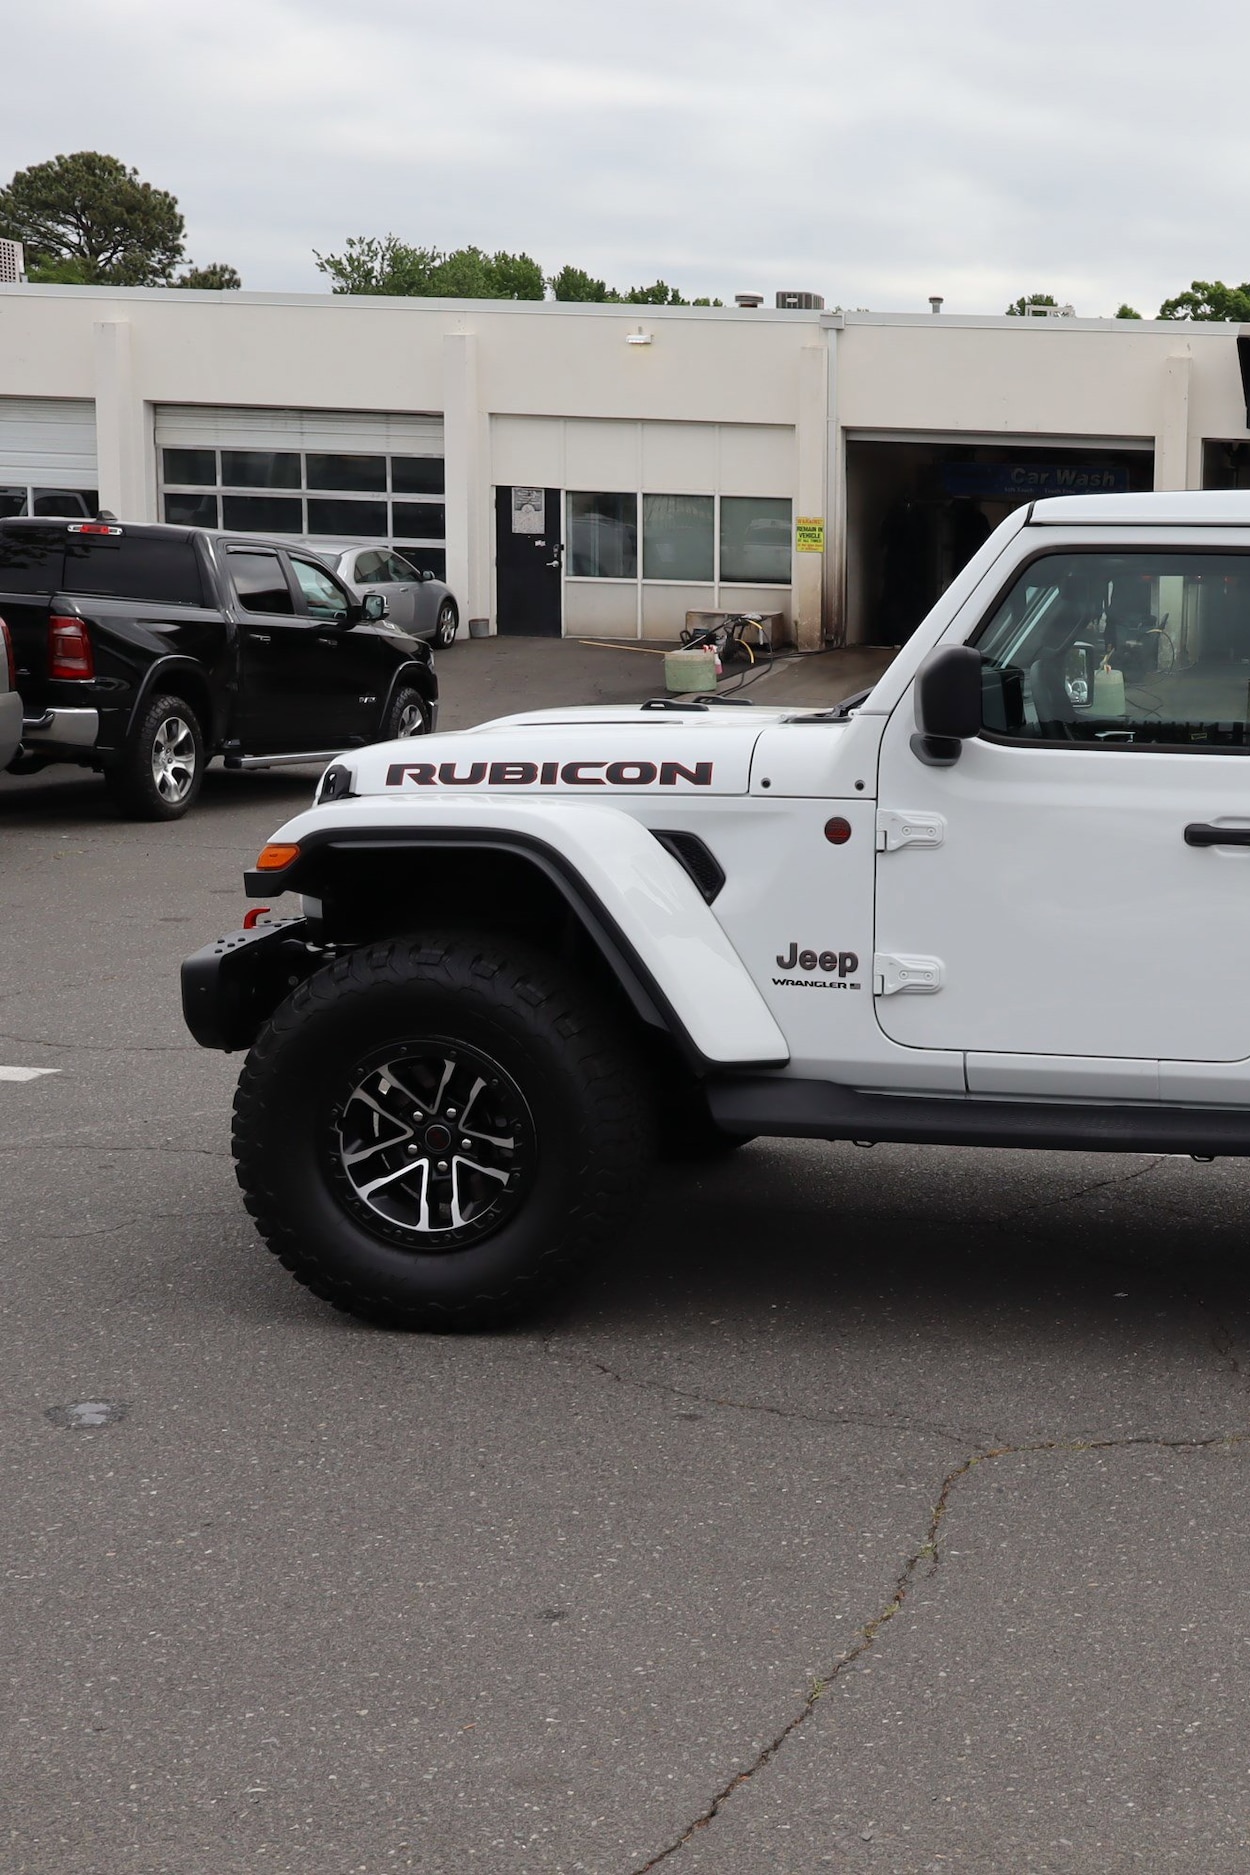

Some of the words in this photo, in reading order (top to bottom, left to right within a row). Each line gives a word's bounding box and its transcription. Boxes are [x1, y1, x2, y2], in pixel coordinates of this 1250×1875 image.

[1012, 468, 1050, 485] Car
[1057, 469, 1115, 487] Wash
[385, 761, 714, 786] RUBICON
[776, 941, 859, 978] Jeep
[772, 977, 847, 989] WRANGLER
